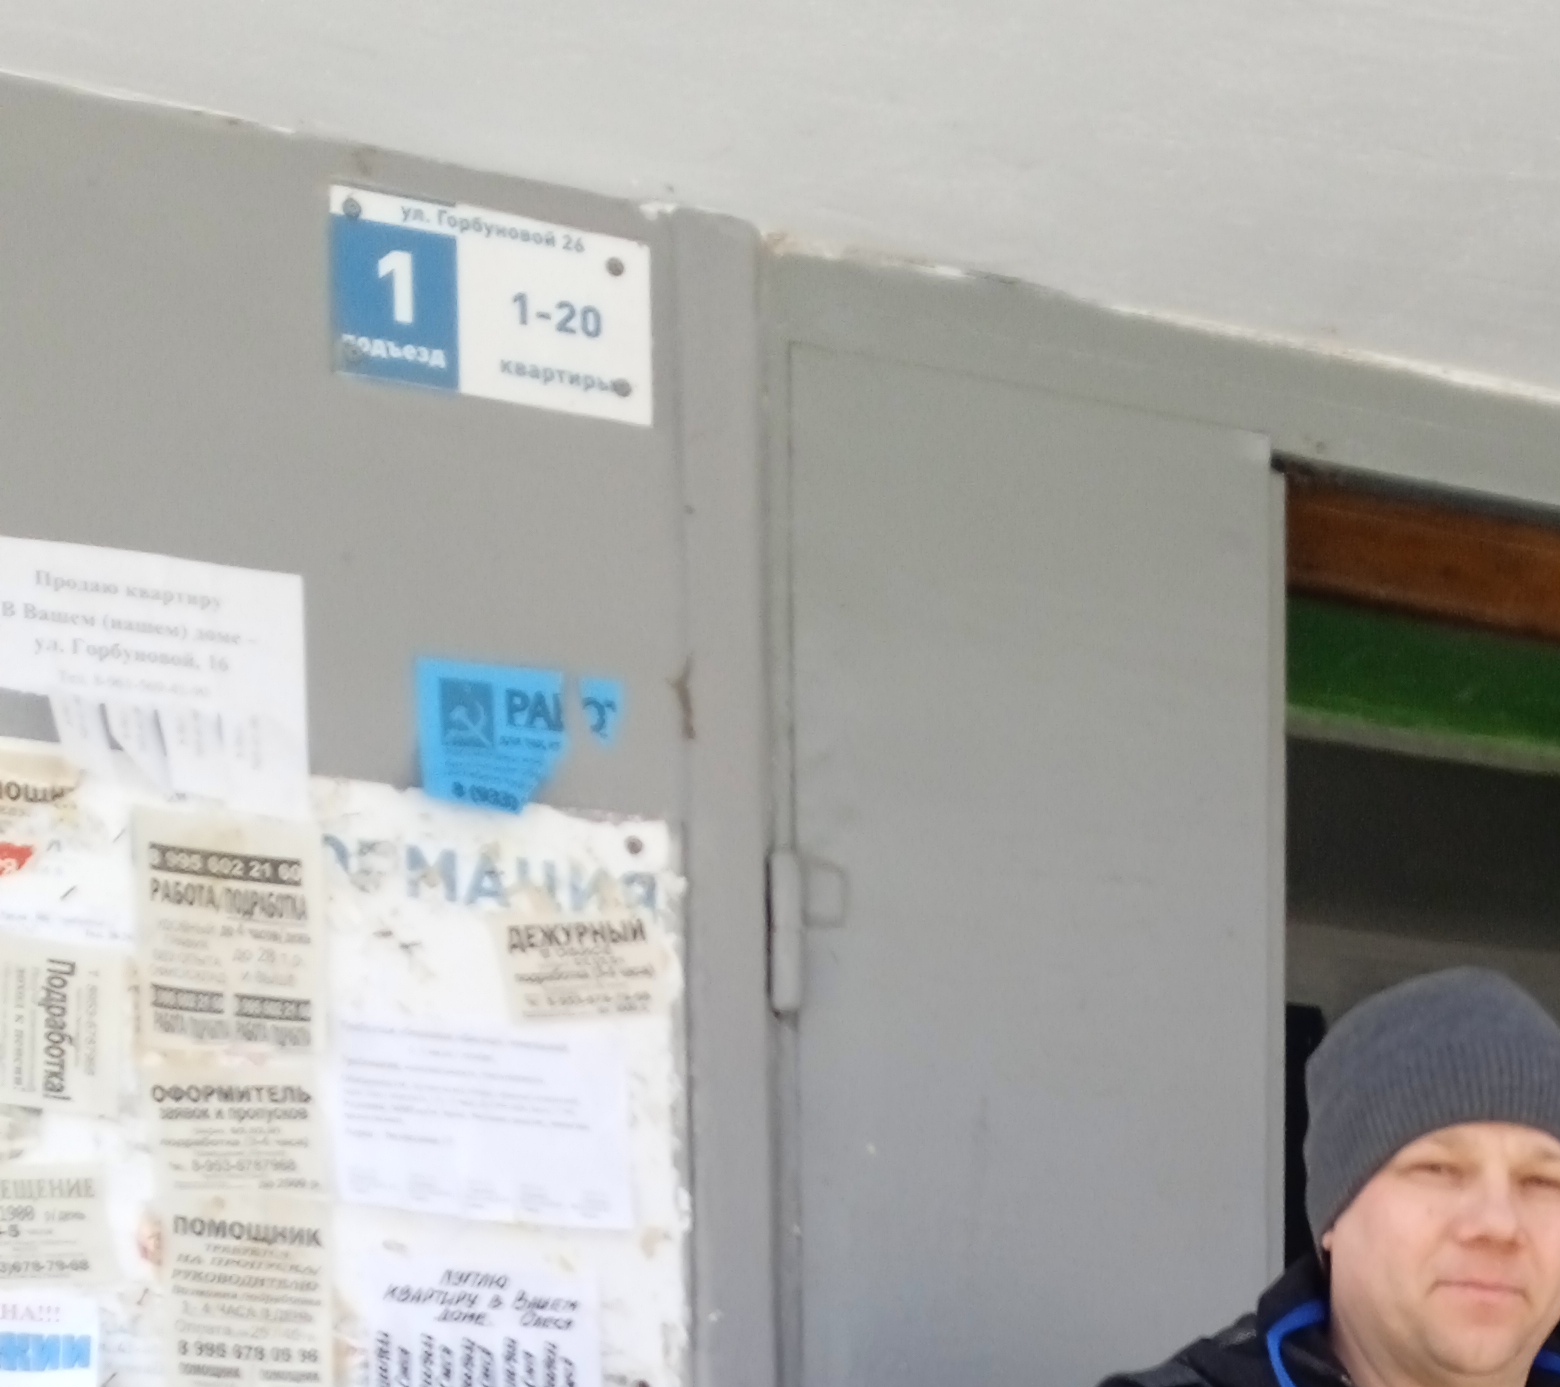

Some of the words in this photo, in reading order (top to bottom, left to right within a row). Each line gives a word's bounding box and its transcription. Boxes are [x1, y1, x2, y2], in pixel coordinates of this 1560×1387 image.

[401, 205, 431, 224] ул.
[437, 208, 556, 248] Горбуновой
[562, 236, 586, 254] 26
[377, 249, 414, 324] 1
[512, 291, 603, 339] 1-20
[35, 569, 119, 596] Продаю
[126, 585, 222, 612] квартиру
[23, 602, 96, 628] Вашем
[508, 918, 646, 954] ДЕЖУРНЫЙ
[37, 957, 76, 1102] Подработка!
[152, 1084, 312, 1103] ОФОРМИТЕЛЬ
[172, 1214, 323, 1247] ПОМОЩНИК
